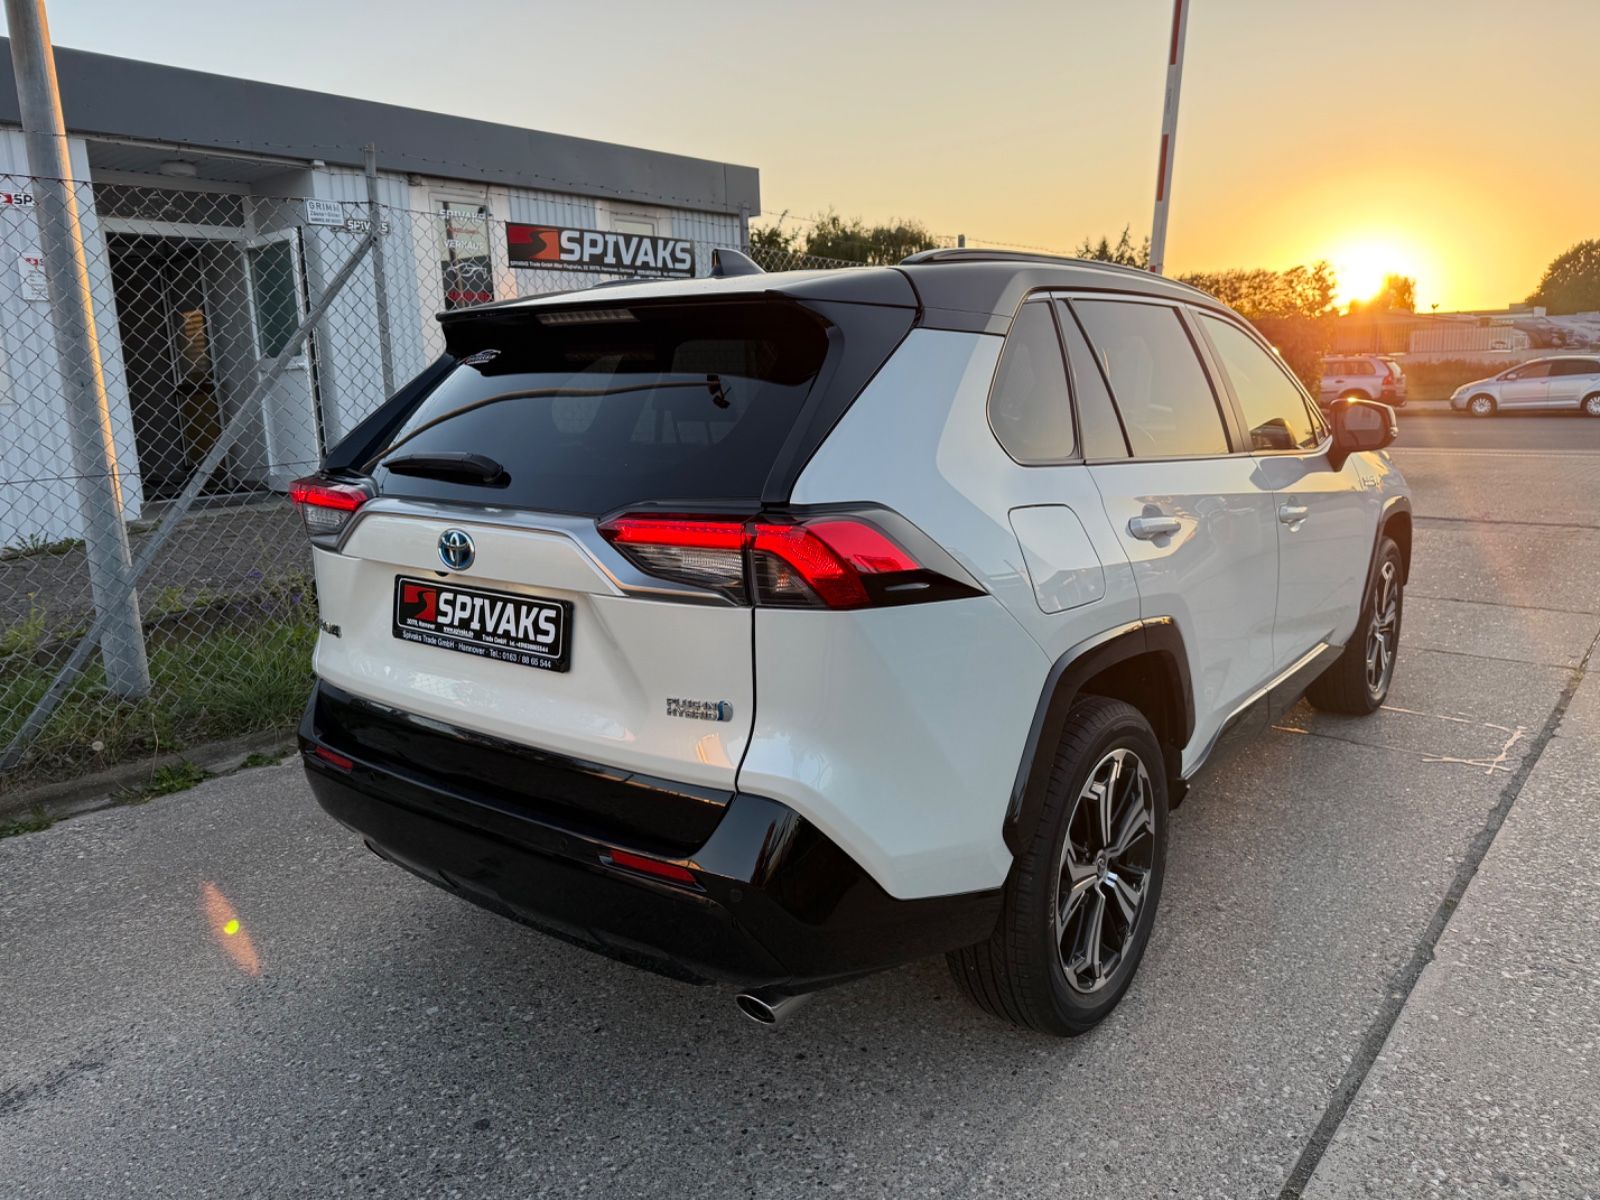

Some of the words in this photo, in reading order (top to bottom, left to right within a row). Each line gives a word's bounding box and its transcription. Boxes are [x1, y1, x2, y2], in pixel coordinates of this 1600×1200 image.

[347, 220, 389, 232] SPIVS
[559, 230, 692, 270] SPIVAKS
[437, 592, 557, 644] SPIVAKS
[402, 630, 422, 641] Spivaks
[422, 634, 438, 645] Trade
[438, 639, 455, 649] GmbH
[458, 643, 486, 655] Hannover
